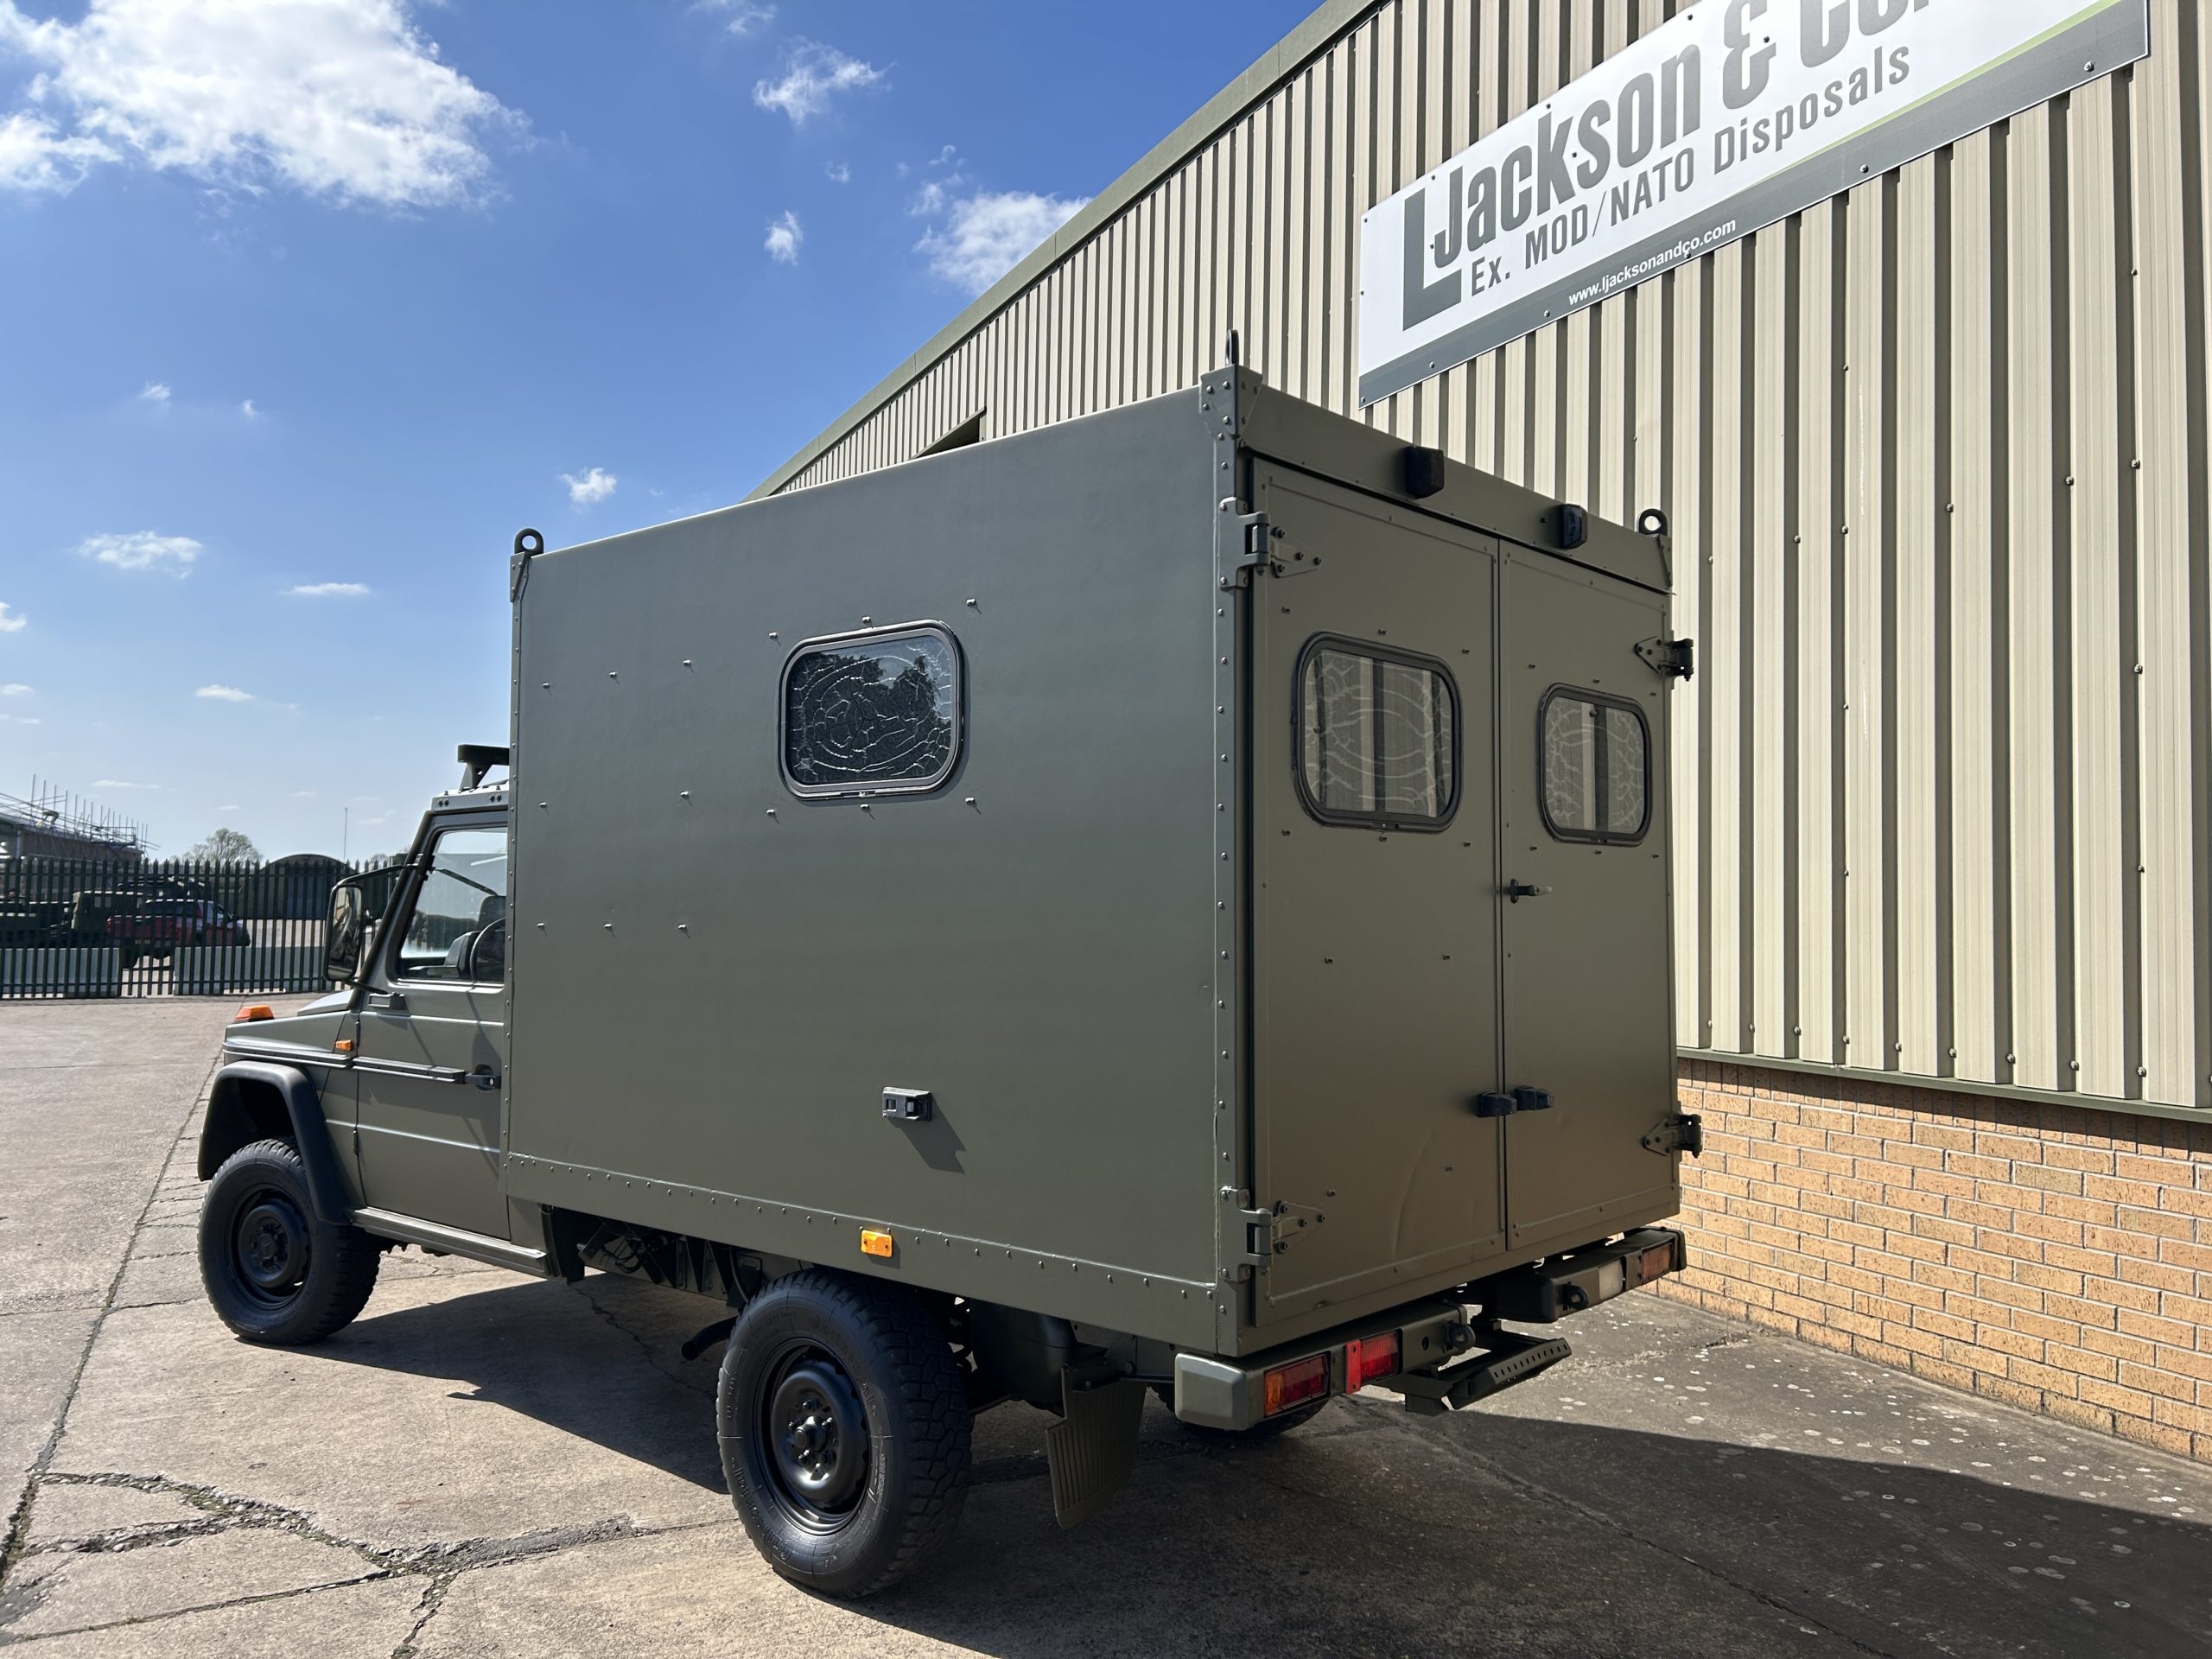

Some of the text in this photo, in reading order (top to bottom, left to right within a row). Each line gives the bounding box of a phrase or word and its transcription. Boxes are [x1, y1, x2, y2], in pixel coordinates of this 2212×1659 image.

[1722, 0, 1777, 110] &
[1471, 45, 1910, 296] Ex. MOD/NATO Disposals
[1568, 219, 1737, 306] www.ljacksonandco.com
